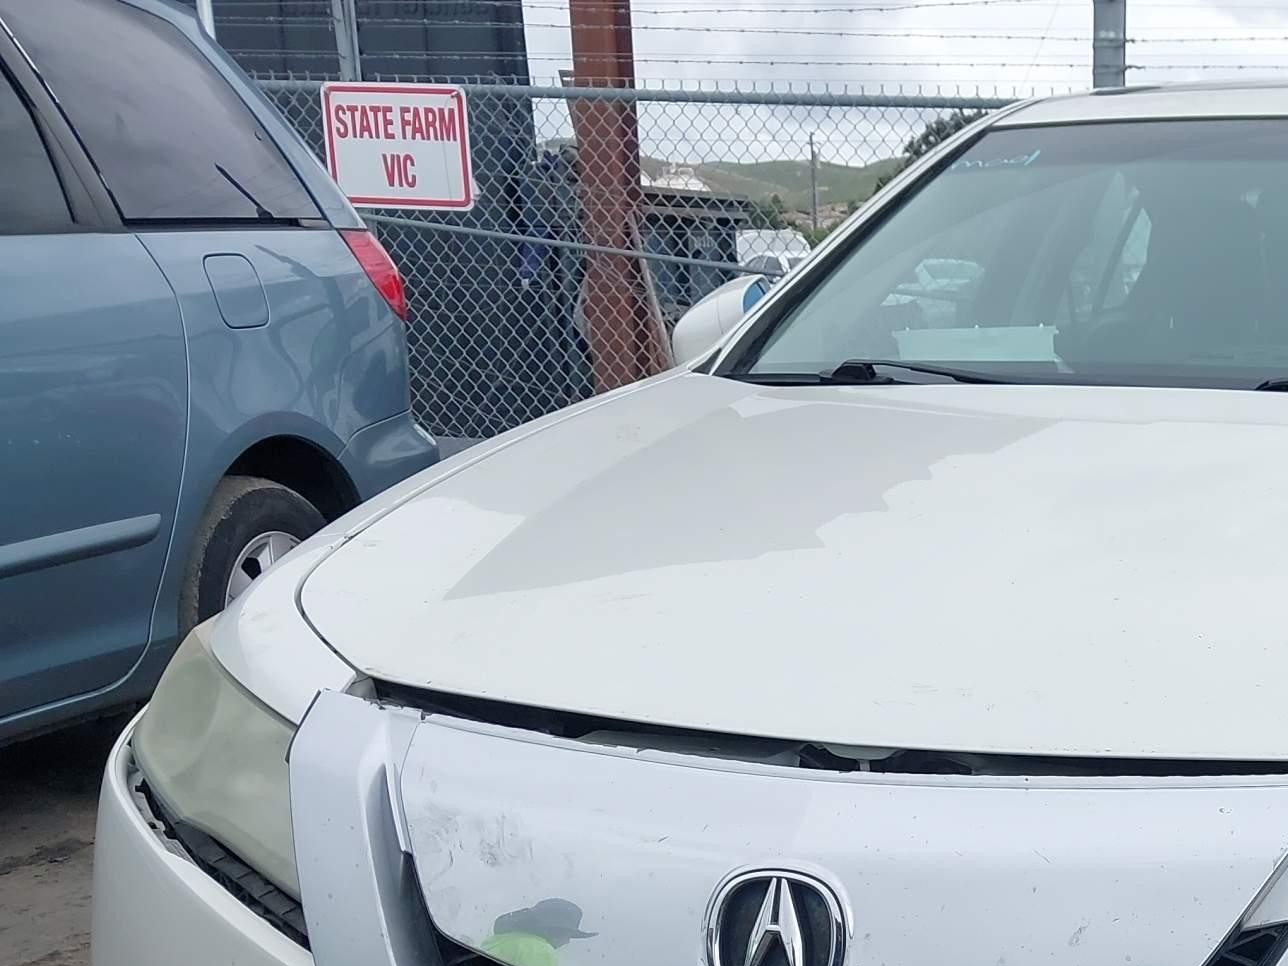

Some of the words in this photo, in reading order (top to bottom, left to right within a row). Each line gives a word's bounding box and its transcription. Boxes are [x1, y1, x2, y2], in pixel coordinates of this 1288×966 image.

[334, 104, 395, 140] STATE
[399, 106, 457, 142] FARM
[381, 153, 416, 188] VIC
